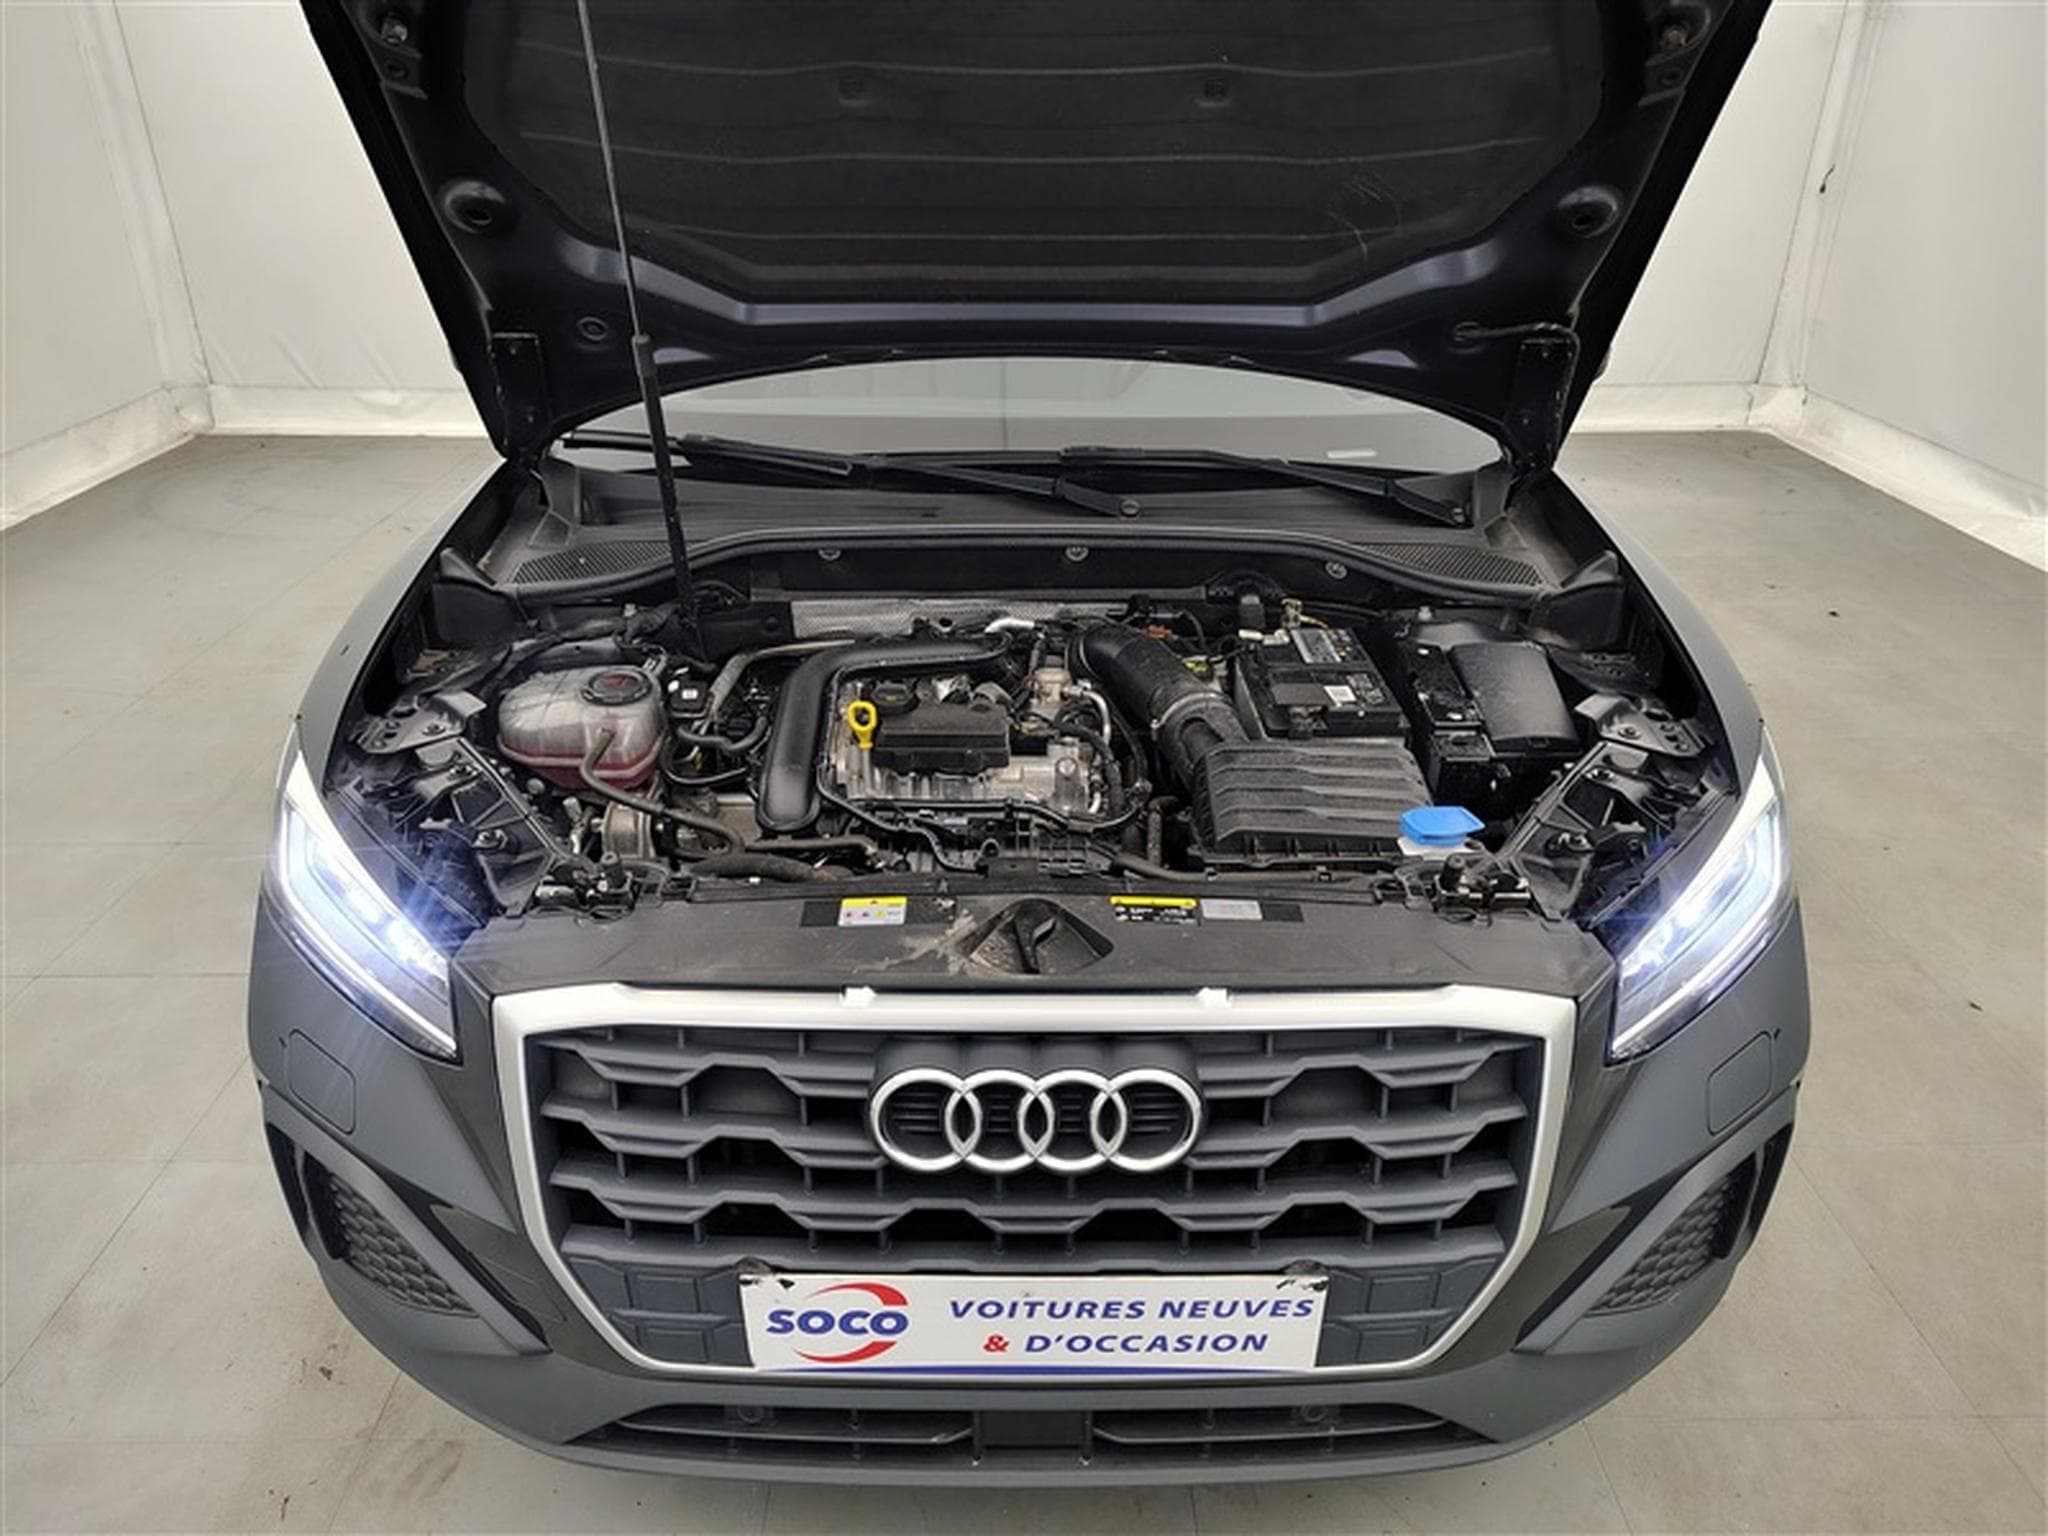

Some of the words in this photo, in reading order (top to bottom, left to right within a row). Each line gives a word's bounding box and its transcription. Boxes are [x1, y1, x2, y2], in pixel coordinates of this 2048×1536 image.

[950, 1299, 1145, 1319] VOITURES
[1159, 1299, 1313, 1319] NEUVES
[767, 1308, 909, 1337] SOCO
[984, 1334, 1009, 1353] &
[1024, 1333, 1267, 1353] D'OCCASION
